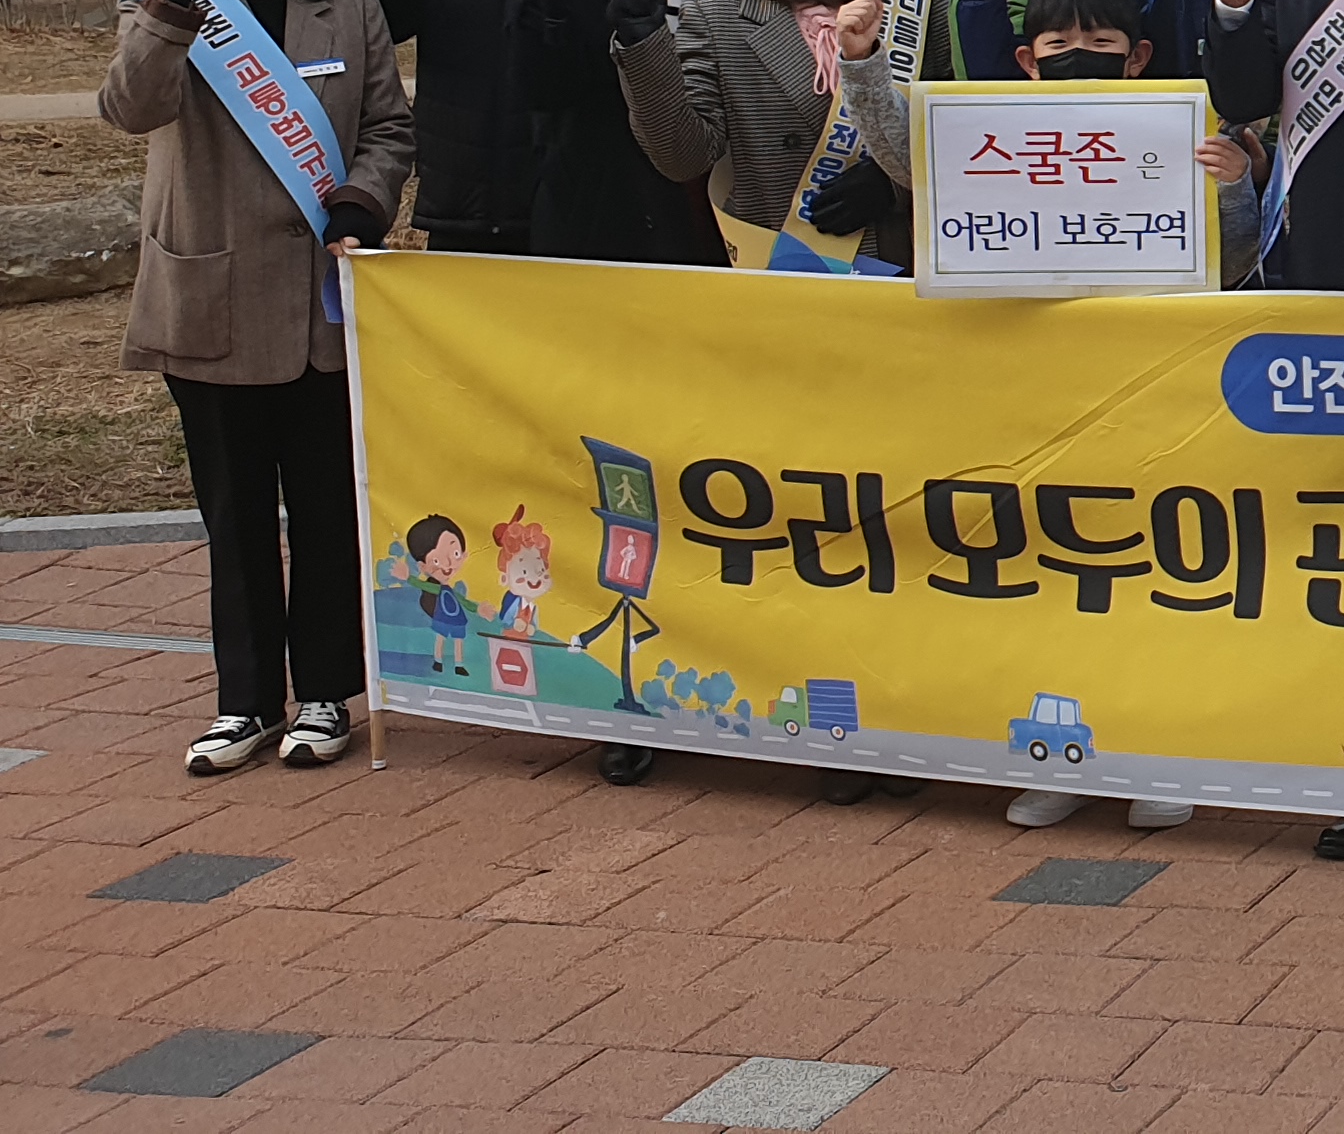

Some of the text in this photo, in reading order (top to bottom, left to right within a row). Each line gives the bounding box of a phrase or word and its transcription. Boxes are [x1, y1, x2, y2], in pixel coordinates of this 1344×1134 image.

[963, 130, 1166, 185] 스쿨존 은
[1287, 79, 1343, 174] 만듭니
[941, 210, 1187, 252] 어린이 보호구역
[679, 458, 896, 594] 우리
[923, 478, 1267, 621] 모두의
